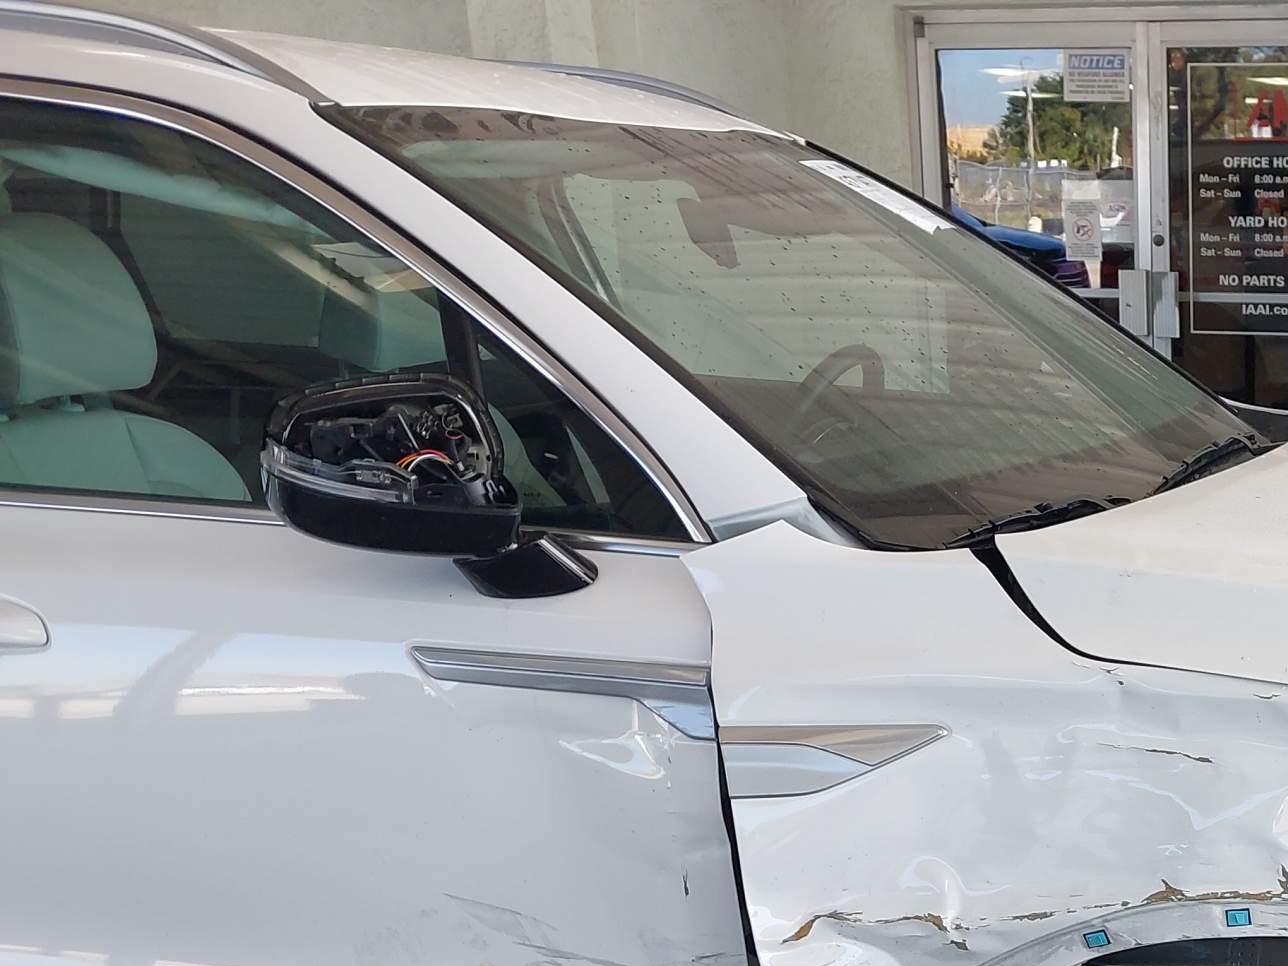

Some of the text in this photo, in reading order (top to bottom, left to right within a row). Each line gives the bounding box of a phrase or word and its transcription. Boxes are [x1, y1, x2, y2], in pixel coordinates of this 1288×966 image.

[1070, 55, 1125, 68] NOTICE
[1223, 157, 1270, 168] OFFICE
[1200, 174, 1219, 182] Mon
[1228, 174, 1240, 182] Fri
[1254, 175, 1273, 183] 8:00
[1200, 189, 1215, 198] Sat
[1224, 189, 1241, 198] Sun
[1254, 189, 1285, 198] Closed
[1228, 216, 1264, 228] YARD
[1200, 233, 1220, 242] Mon
[1229, 233, 1240, 242] Fri
[1254, 234, 1273, 242] 8:00
[1200, 248, 1216, 257] Sat
[1224, 248, 1242, 257] Sun
[1254, 248, 1285, 257] Closed
[1219, 275, 1239, 286] NO
[1242, 275, 1285, 287] PARTS
